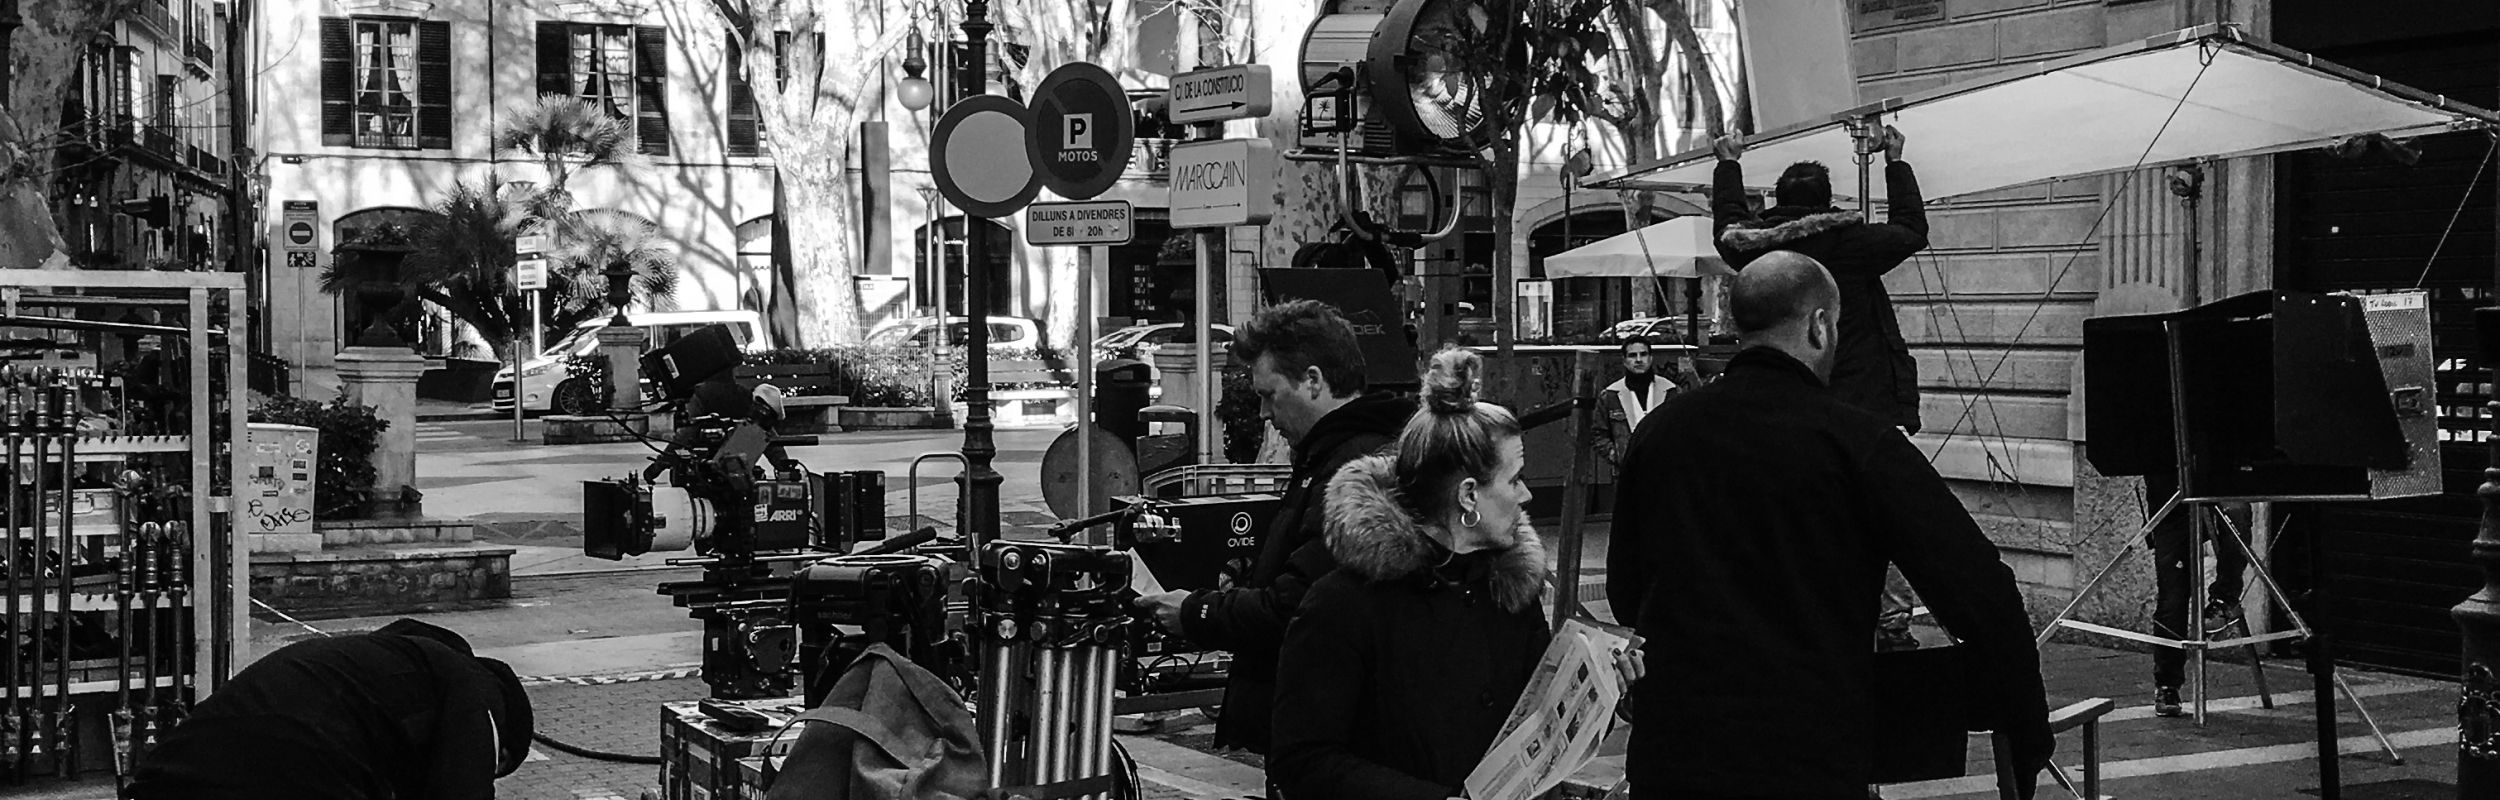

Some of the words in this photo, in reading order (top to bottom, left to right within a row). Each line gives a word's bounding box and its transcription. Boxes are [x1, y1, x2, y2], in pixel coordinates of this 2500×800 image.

[1185, 81, 1193, 99] DE
[1194, 80, 1202, 98] LA
[1070, 117, 1087, 145] P
[1058, 150, 1098, 162] MOTOS
[1032, 210, 1067, 221] DILLUNS
[1069, 209, 1075, 220] A
[1077, 208, 1125, 221] DIVENDRES
[1053, 226, 1064, 237] DE
[1087, 225, 1103, 237] 20h
[769, 509, 797, 521] ARRI
[1227, 537, 1255, 548] OVIDE
